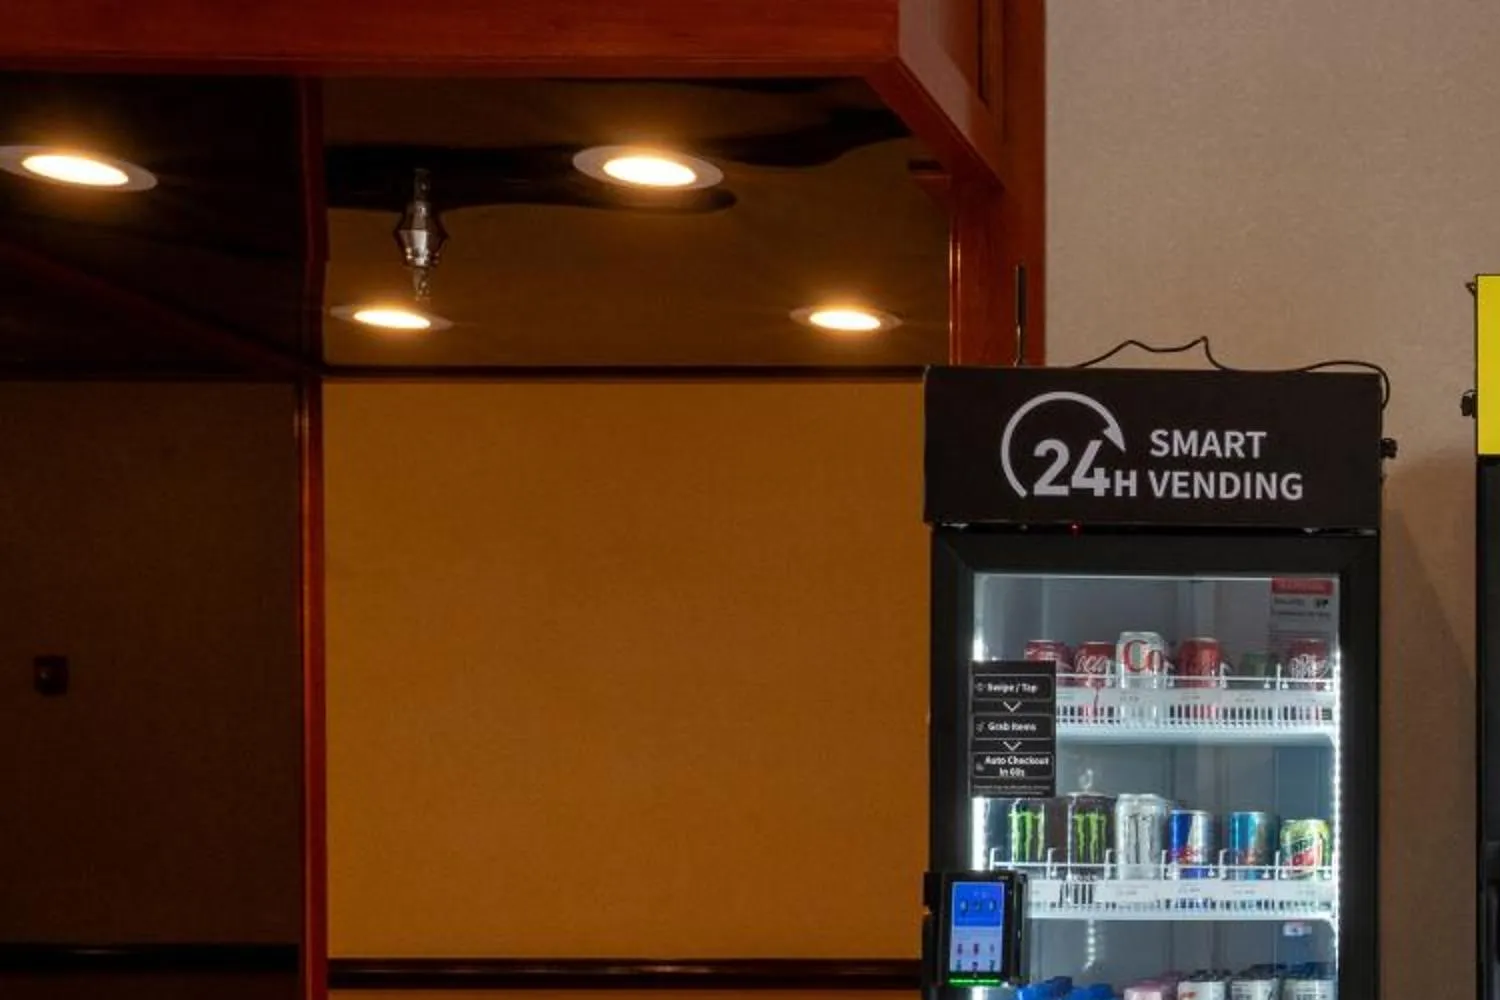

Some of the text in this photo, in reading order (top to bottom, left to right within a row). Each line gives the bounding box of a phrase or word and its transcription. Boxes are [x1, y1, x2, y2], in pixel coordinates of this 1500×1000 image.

[1150, 429, 1267, 459] SMART
[1148, 470, 1303, 501] VENDING
[987, 721, 1010, 731] Grab
[984, 755, 1049, 765] Auto Checkout
